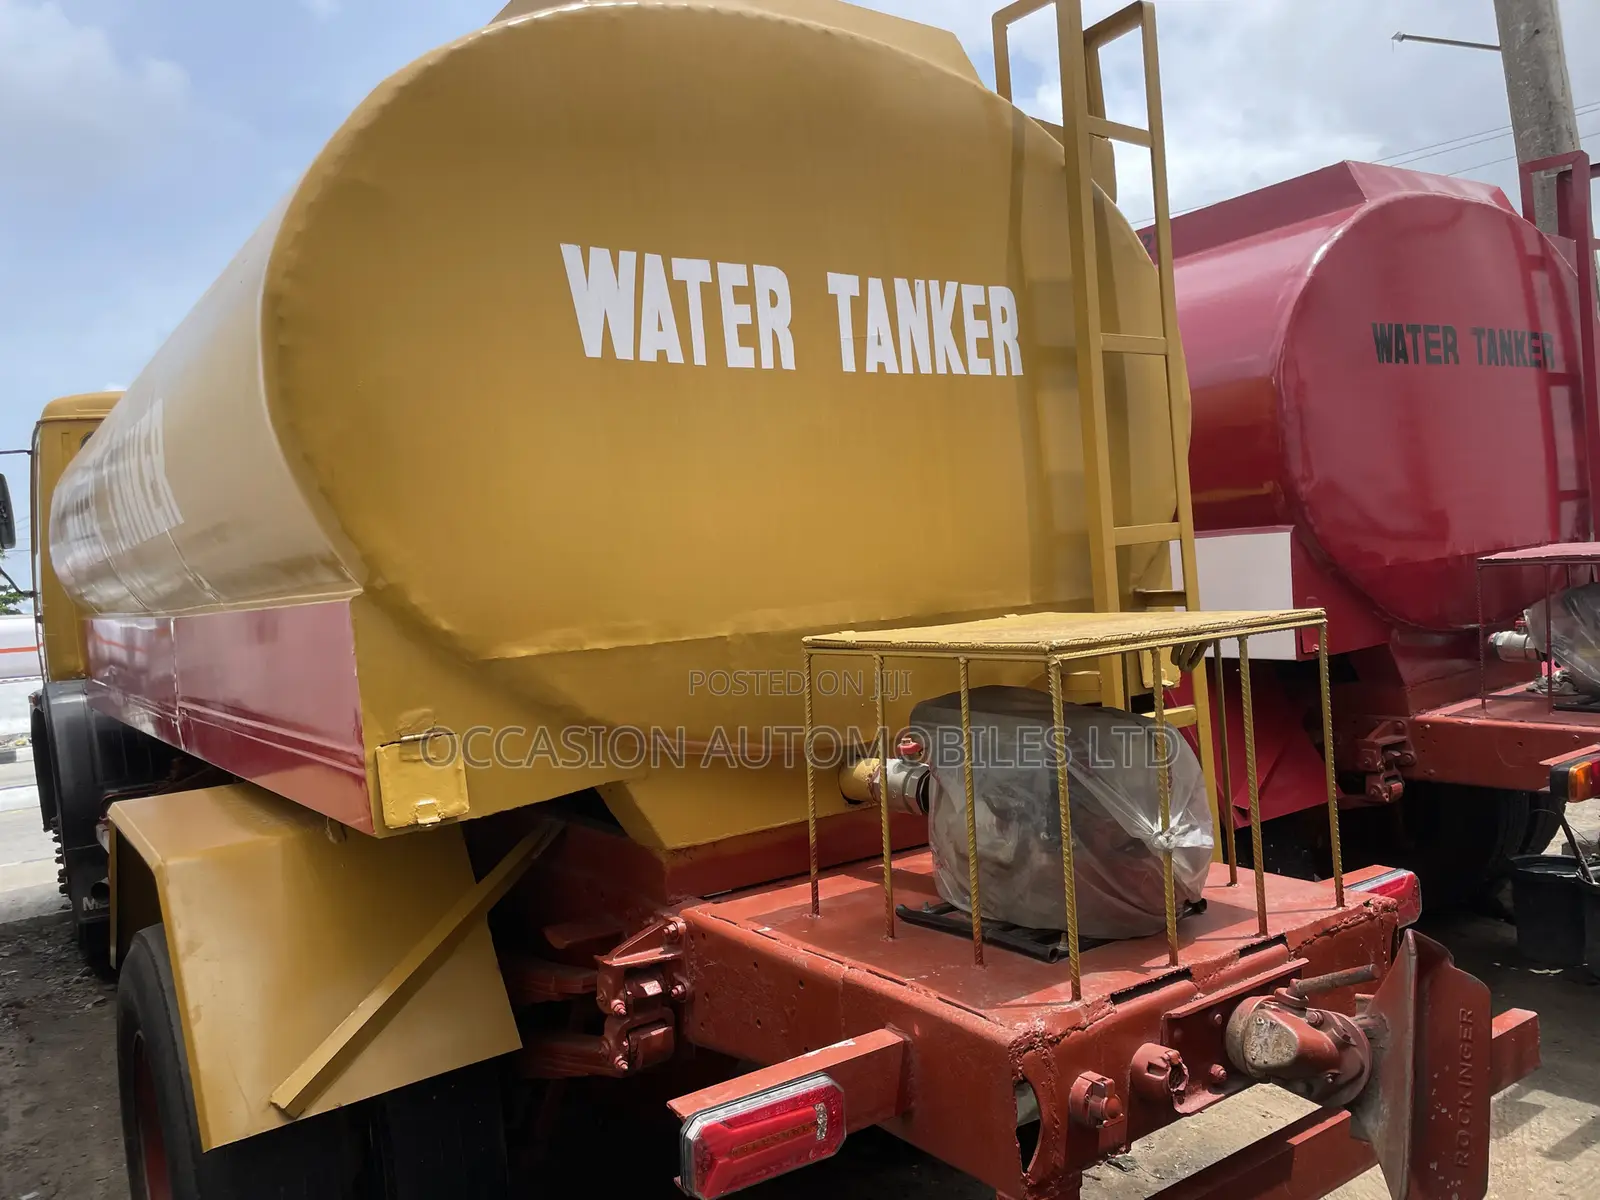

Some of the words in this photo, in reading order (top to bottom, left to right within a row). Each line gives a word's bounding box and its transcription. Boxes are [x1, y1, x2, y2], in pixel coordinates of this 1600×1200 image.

[560, 243, 796, 371] WATER
[827, 271, 1023, 376] TANKER
[1371, 322, 1460, 365] WATER
[1471, 326, 1555, 370] TANKER
[1454, 1007, 1475, 1168] ROCKINGER
